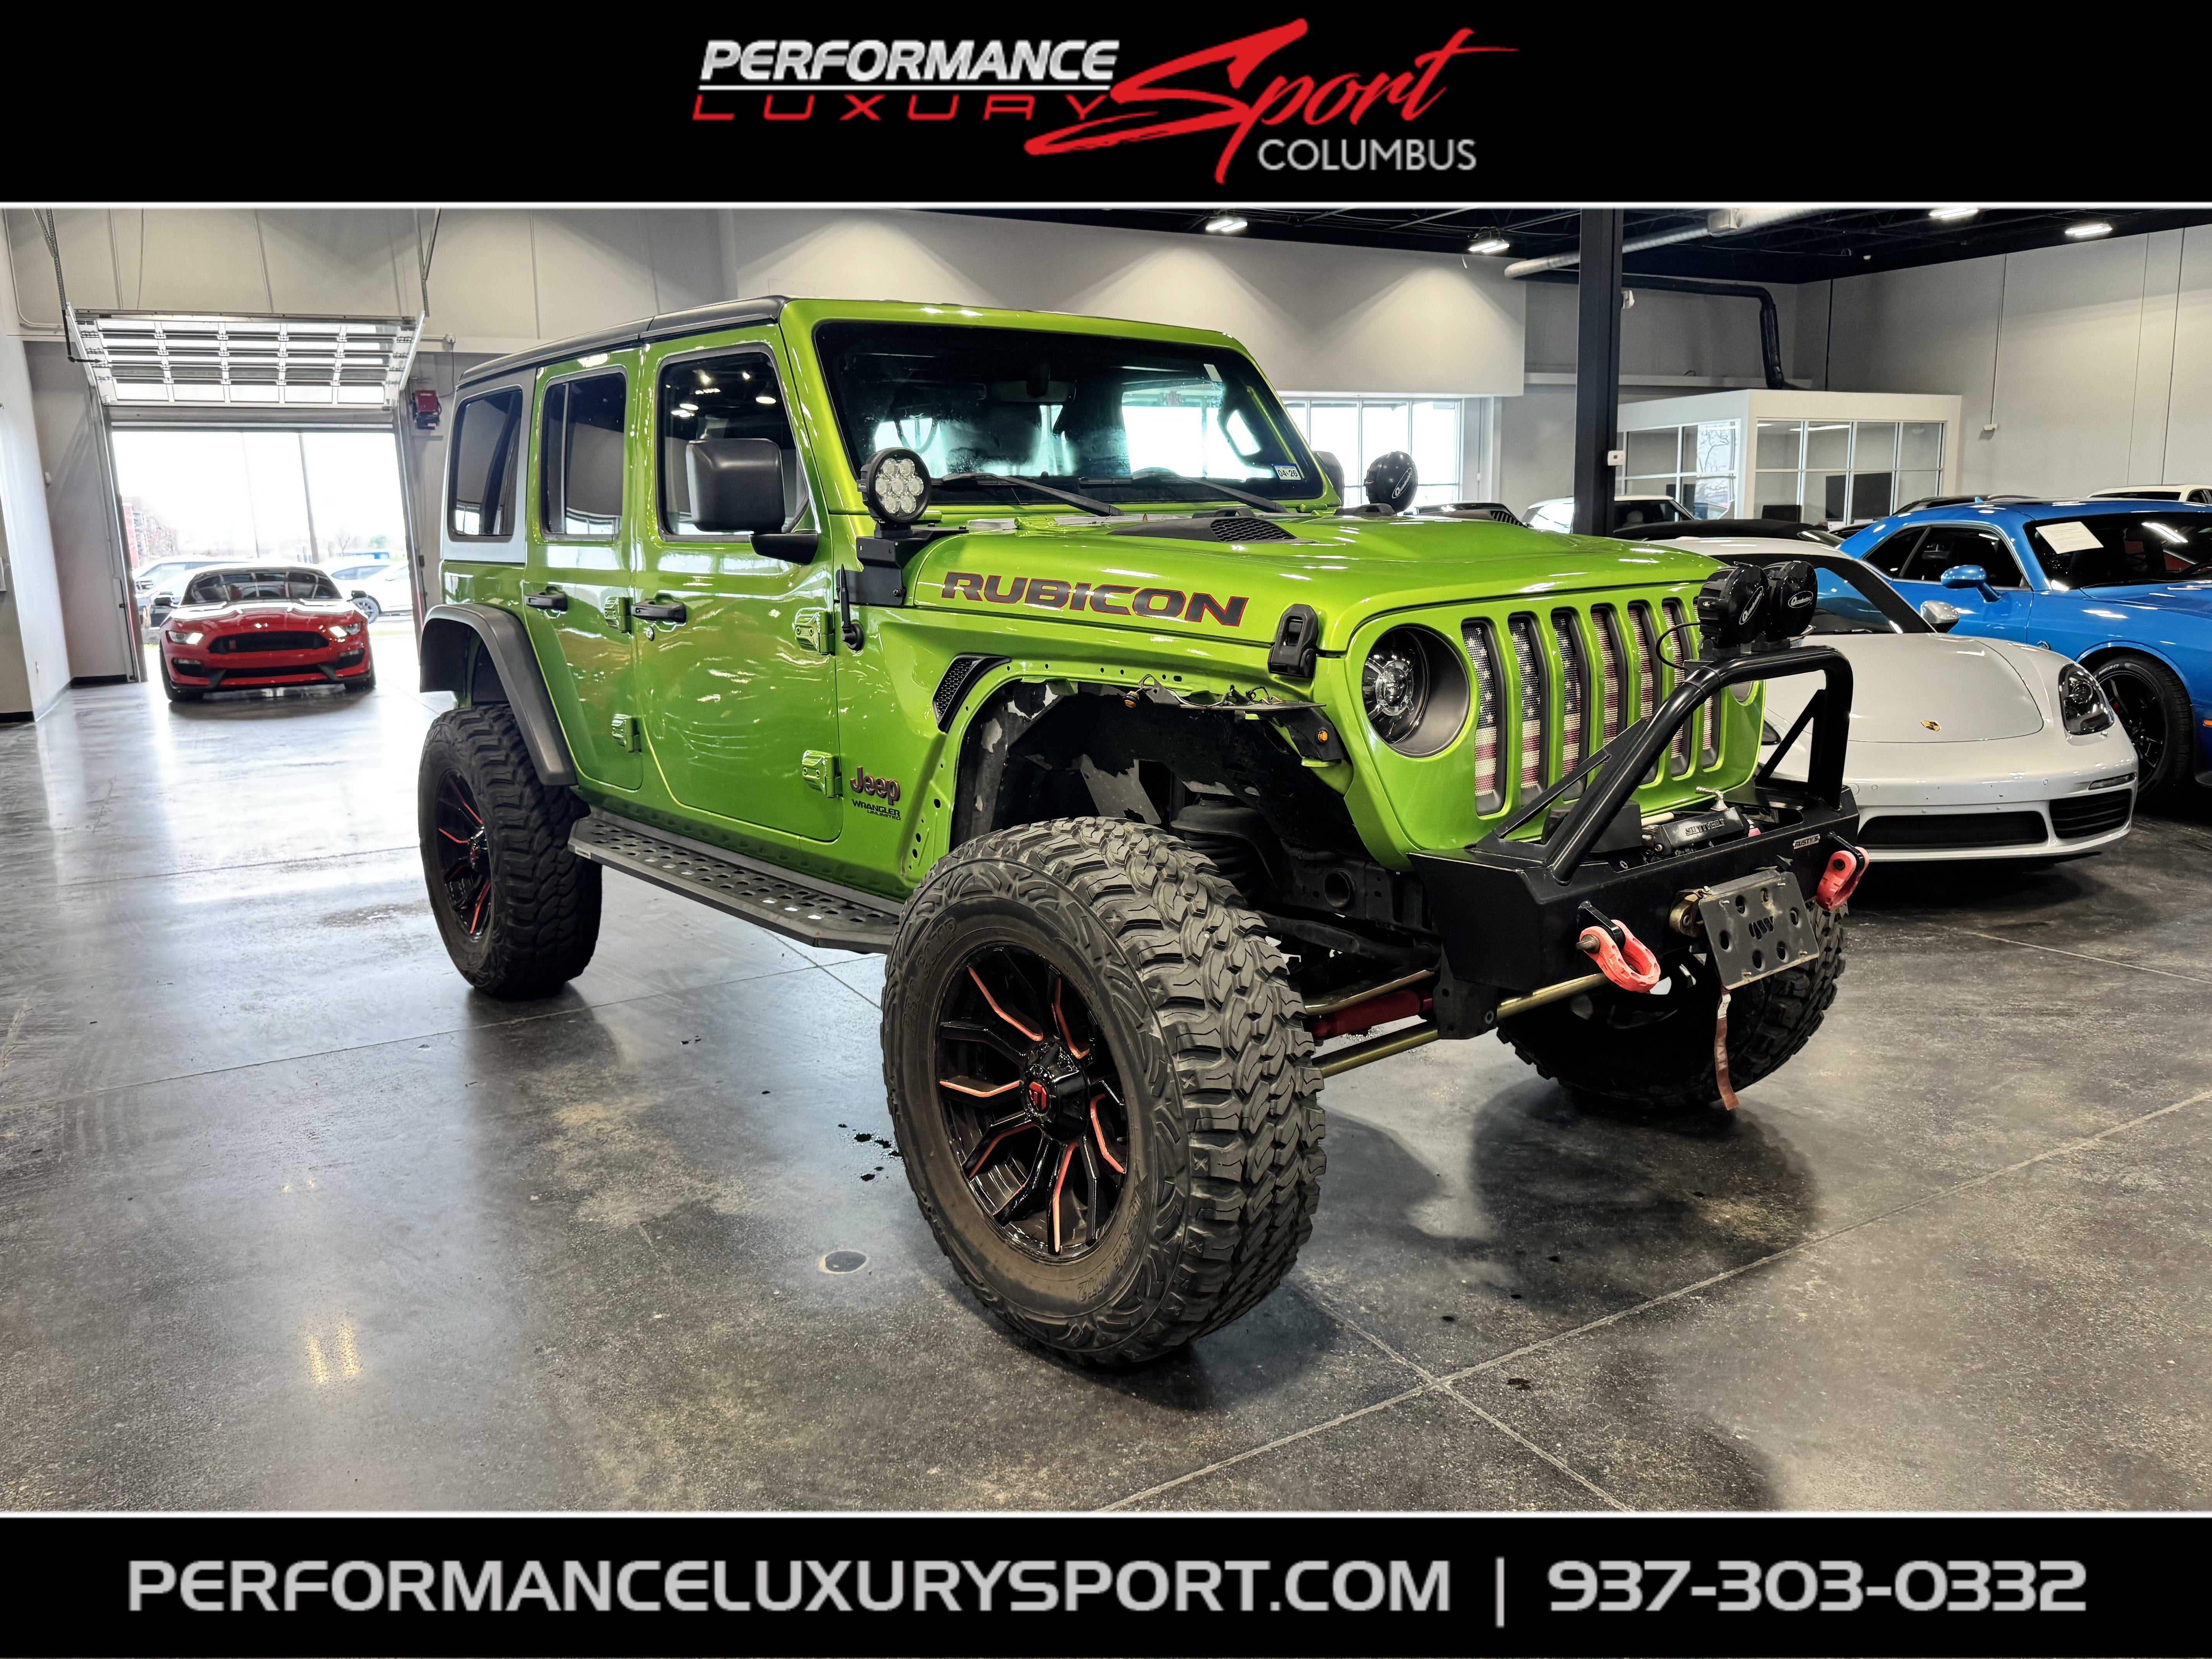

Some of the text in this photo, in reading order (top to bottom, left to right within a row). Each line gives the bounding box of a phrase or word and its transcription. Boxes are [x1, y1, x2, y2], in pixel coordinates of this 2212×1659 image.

[941, 571, 1249, 627] RUBICON
[850, 766, 900, 806] Jeep
[852, 799, 900, 817] WRANGLER
[867, 809, 901, 821] UNLIMITED
[1795, 836, 1819, 847] RUSTYS
